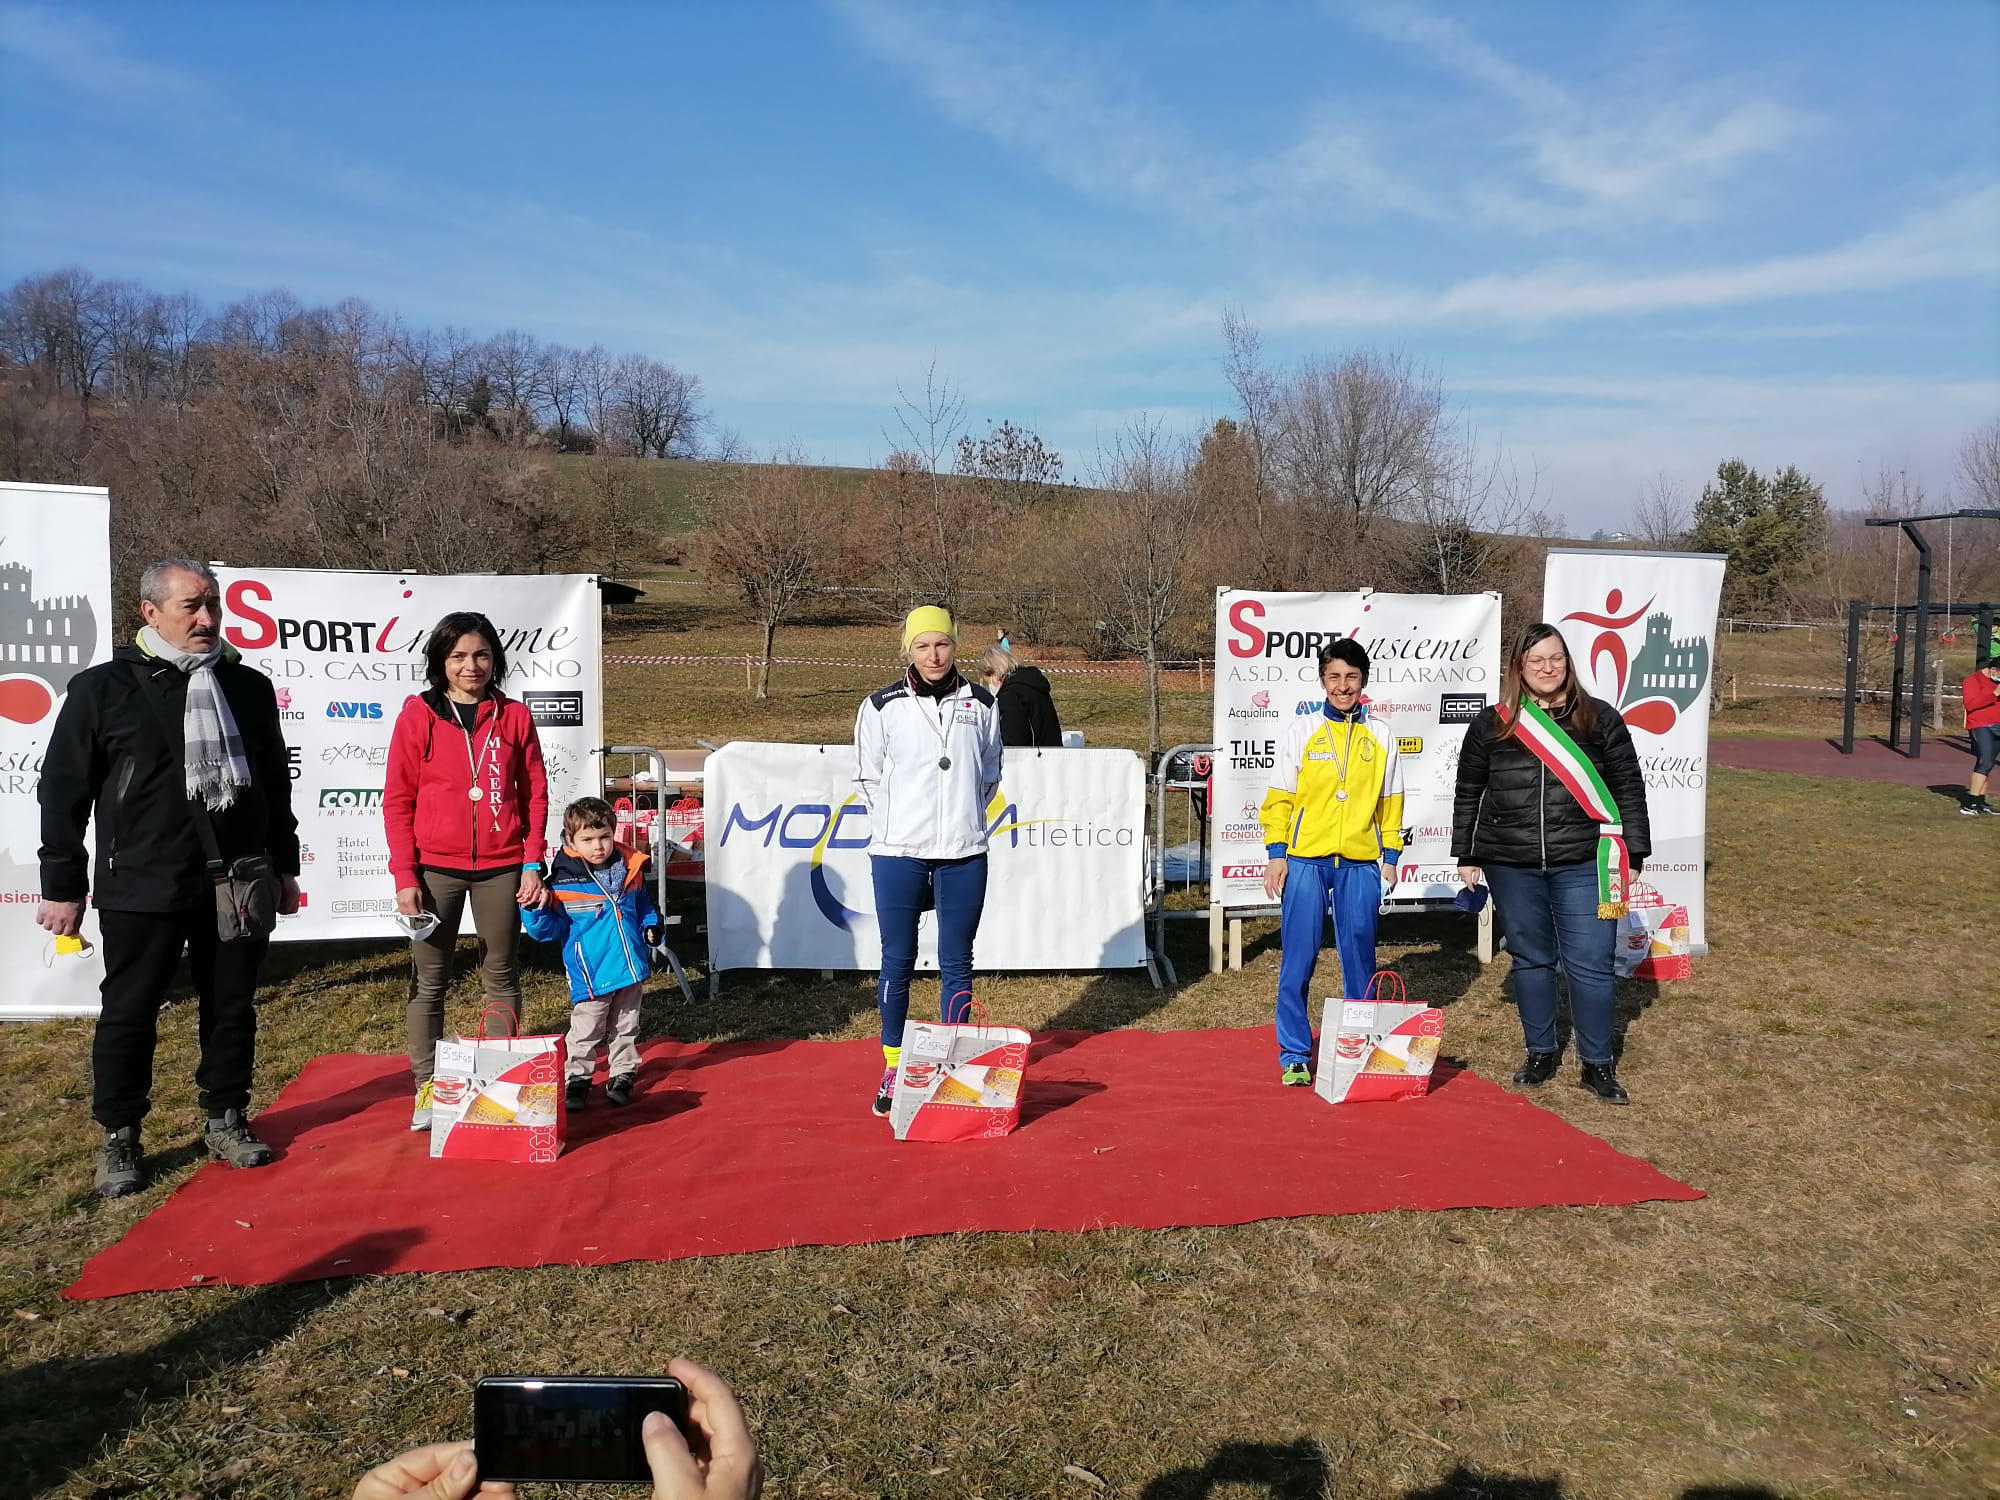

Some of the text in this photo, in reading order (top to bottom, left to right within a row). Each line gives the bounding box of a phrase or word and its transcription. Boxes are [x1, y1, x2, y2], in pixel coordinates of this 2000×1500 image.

[324, 658, 582, 682] CASTEANO
[1228, 665, 1289, 682] A.S.D.
[326, 701, 384, 719] AVIS
[531, 701, 576, 711] CDC
[1389, 703, 1432, 712] SPRAYING
[1445, 701, 1482, 711] CDC
[1228, 707, 1279, 719] Acquolina
[1230, 740, 1276, 756] TILE
[1229, 757, 1275, 769] TREND
[484, 736, 503, 832] MINERVA
[318, 809, 376, 817] IMPIAN
[337, 837, 370, 848] Hotel
[337, 851, 391, 862] Ristoran
[337, 866, 387, 879] Pizzeria
